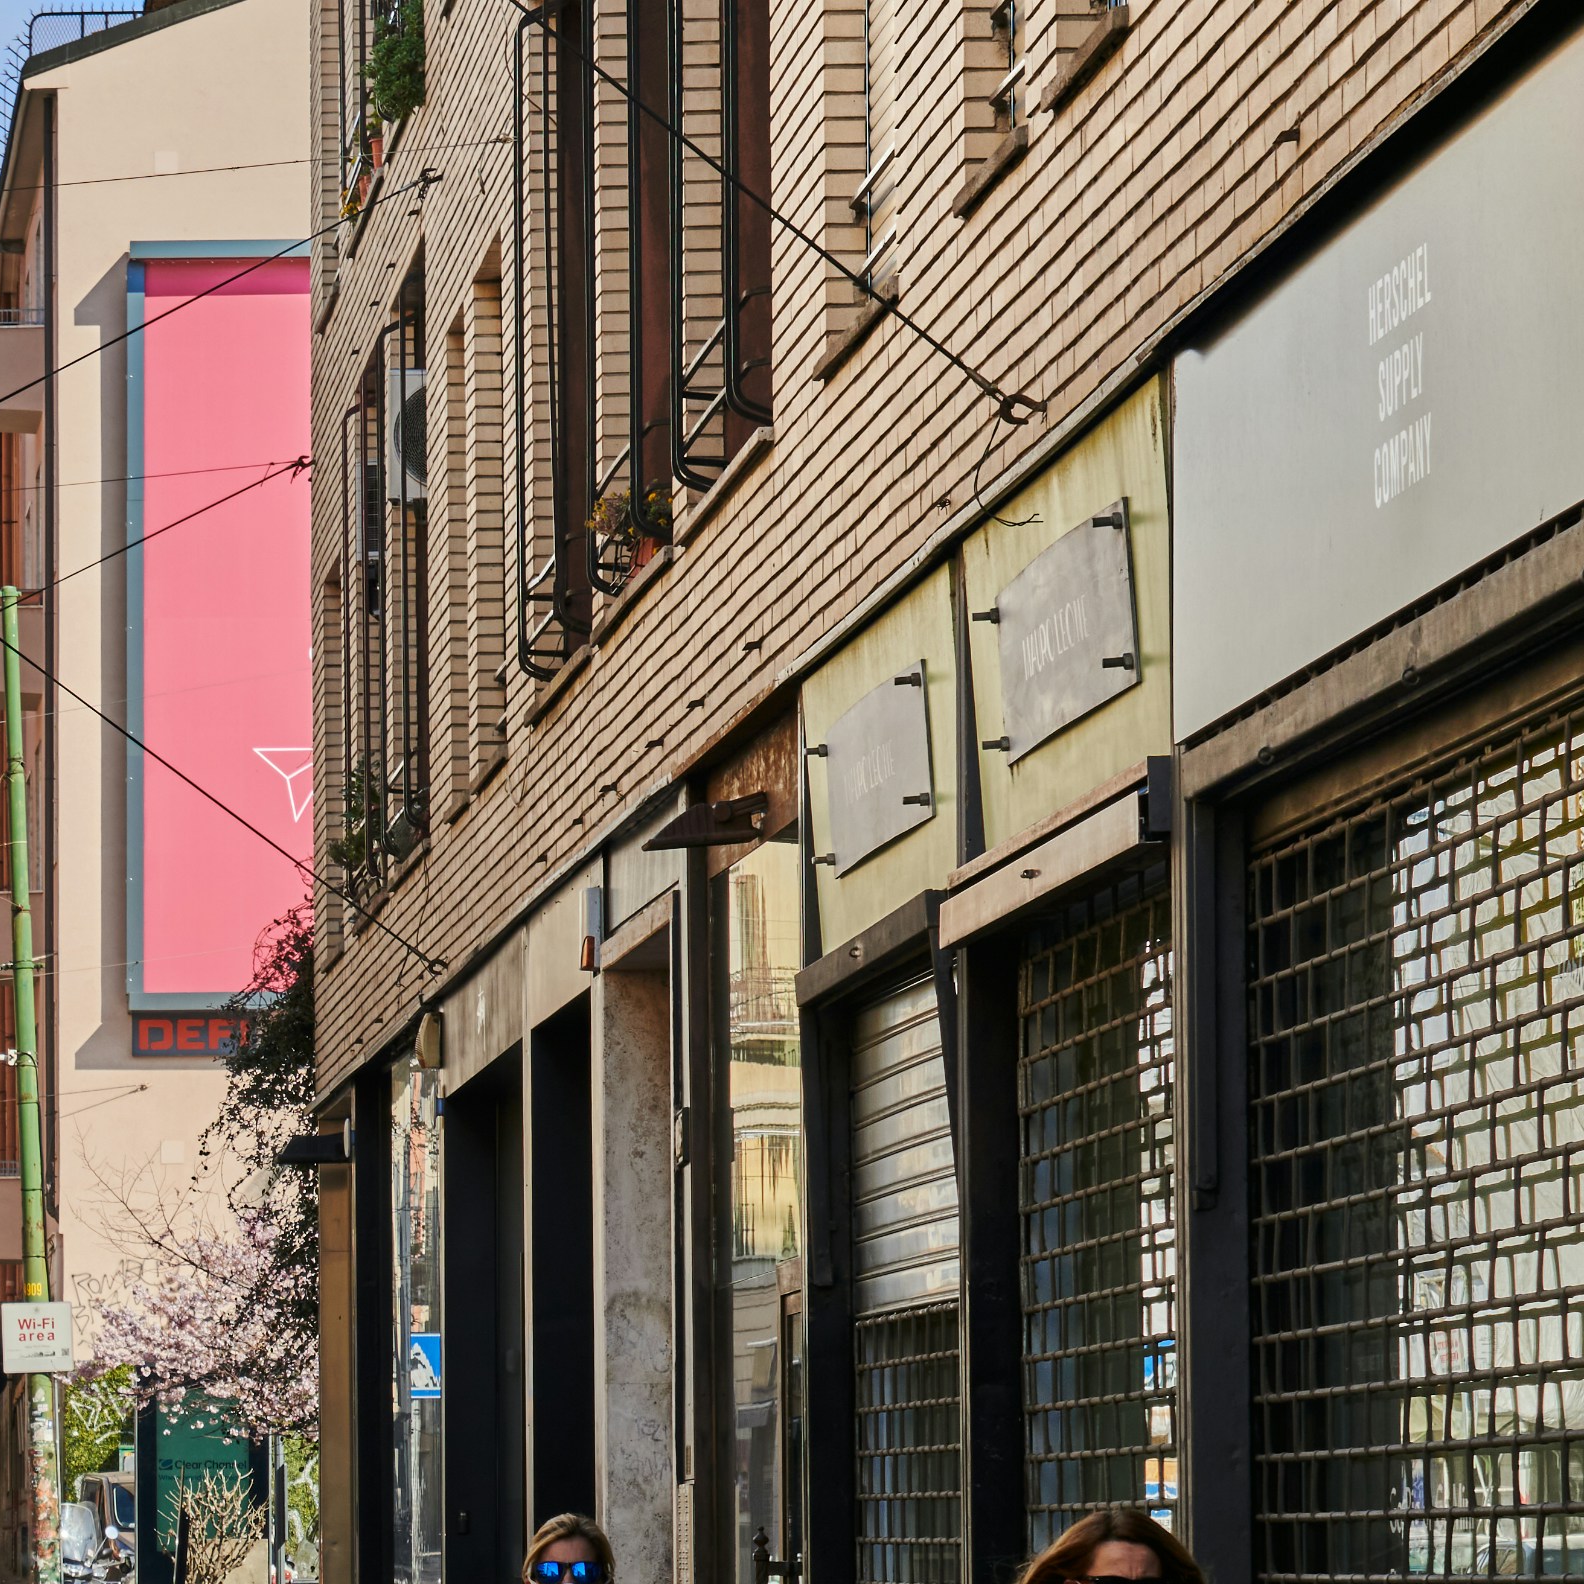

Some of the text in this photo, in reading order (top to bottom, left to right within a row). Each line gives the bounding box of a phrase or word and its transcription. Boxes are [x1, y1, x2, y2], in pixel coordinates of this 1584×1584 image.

[1368, 242, 1432, 346] HERSCHEL
[1378, 331, 1424, 423] SUPPLY
[1373, 411, 1432, 509] COMPANY
[18, 1317, 55, 1330] Wi-Fi
[18, 1331, 56, 1342] area
[174, 1459, 203, 1470] Clear
